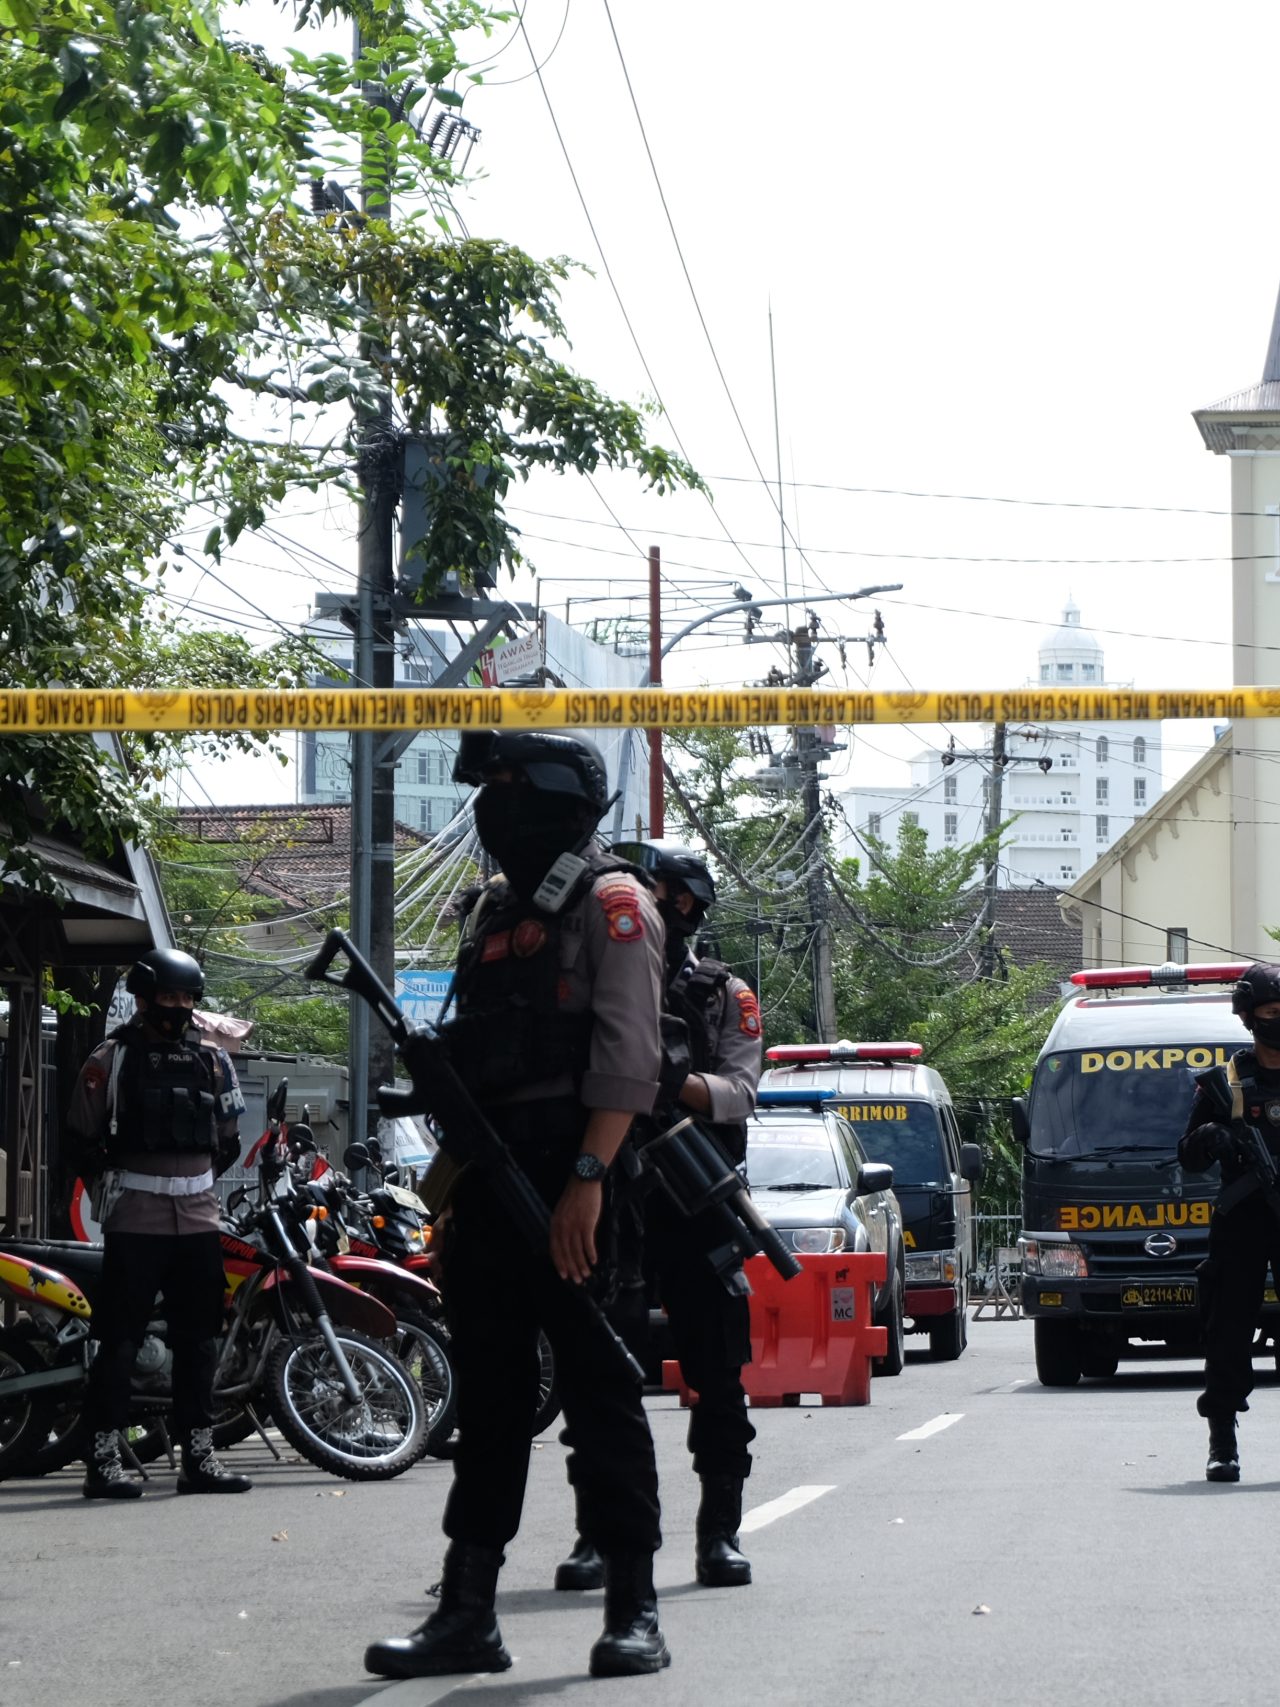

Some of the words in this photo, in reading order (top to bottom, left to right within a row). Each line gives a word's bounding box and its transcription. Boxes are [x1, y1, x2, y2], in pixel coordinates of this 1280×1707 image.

[500, 640, 533, 661] AWAS
[35, 694, 125, 725] DILARANG
[188, 694, 247, 725] POLISI
[255, 694, 309, 725] GARIS
[310, 694, 406, 725] MELINTAS
[413, 694, 502, 725] DILARANG
[565, 694, 623, 724] POLISI
[630, 695, 684, 724] GARIS
[684, 695, 779, 723] MELINTAS
[786, 695, 874, 722] DILARANG
[937, 695, 995, 721] POLISI
[1001, 695, 1054, 721] GARIS
[1059, 695, 1149, 720] MELINTAS
[1158, 695, 1244, 718] DILARANG
[168, 1053, 193, 1062] POLISI
[1080, 1047, 1232, 1074] DOKPOL
[837, 1105, 908, 1121] BRIMOB
[834, 1307, 852, 1318] MC
